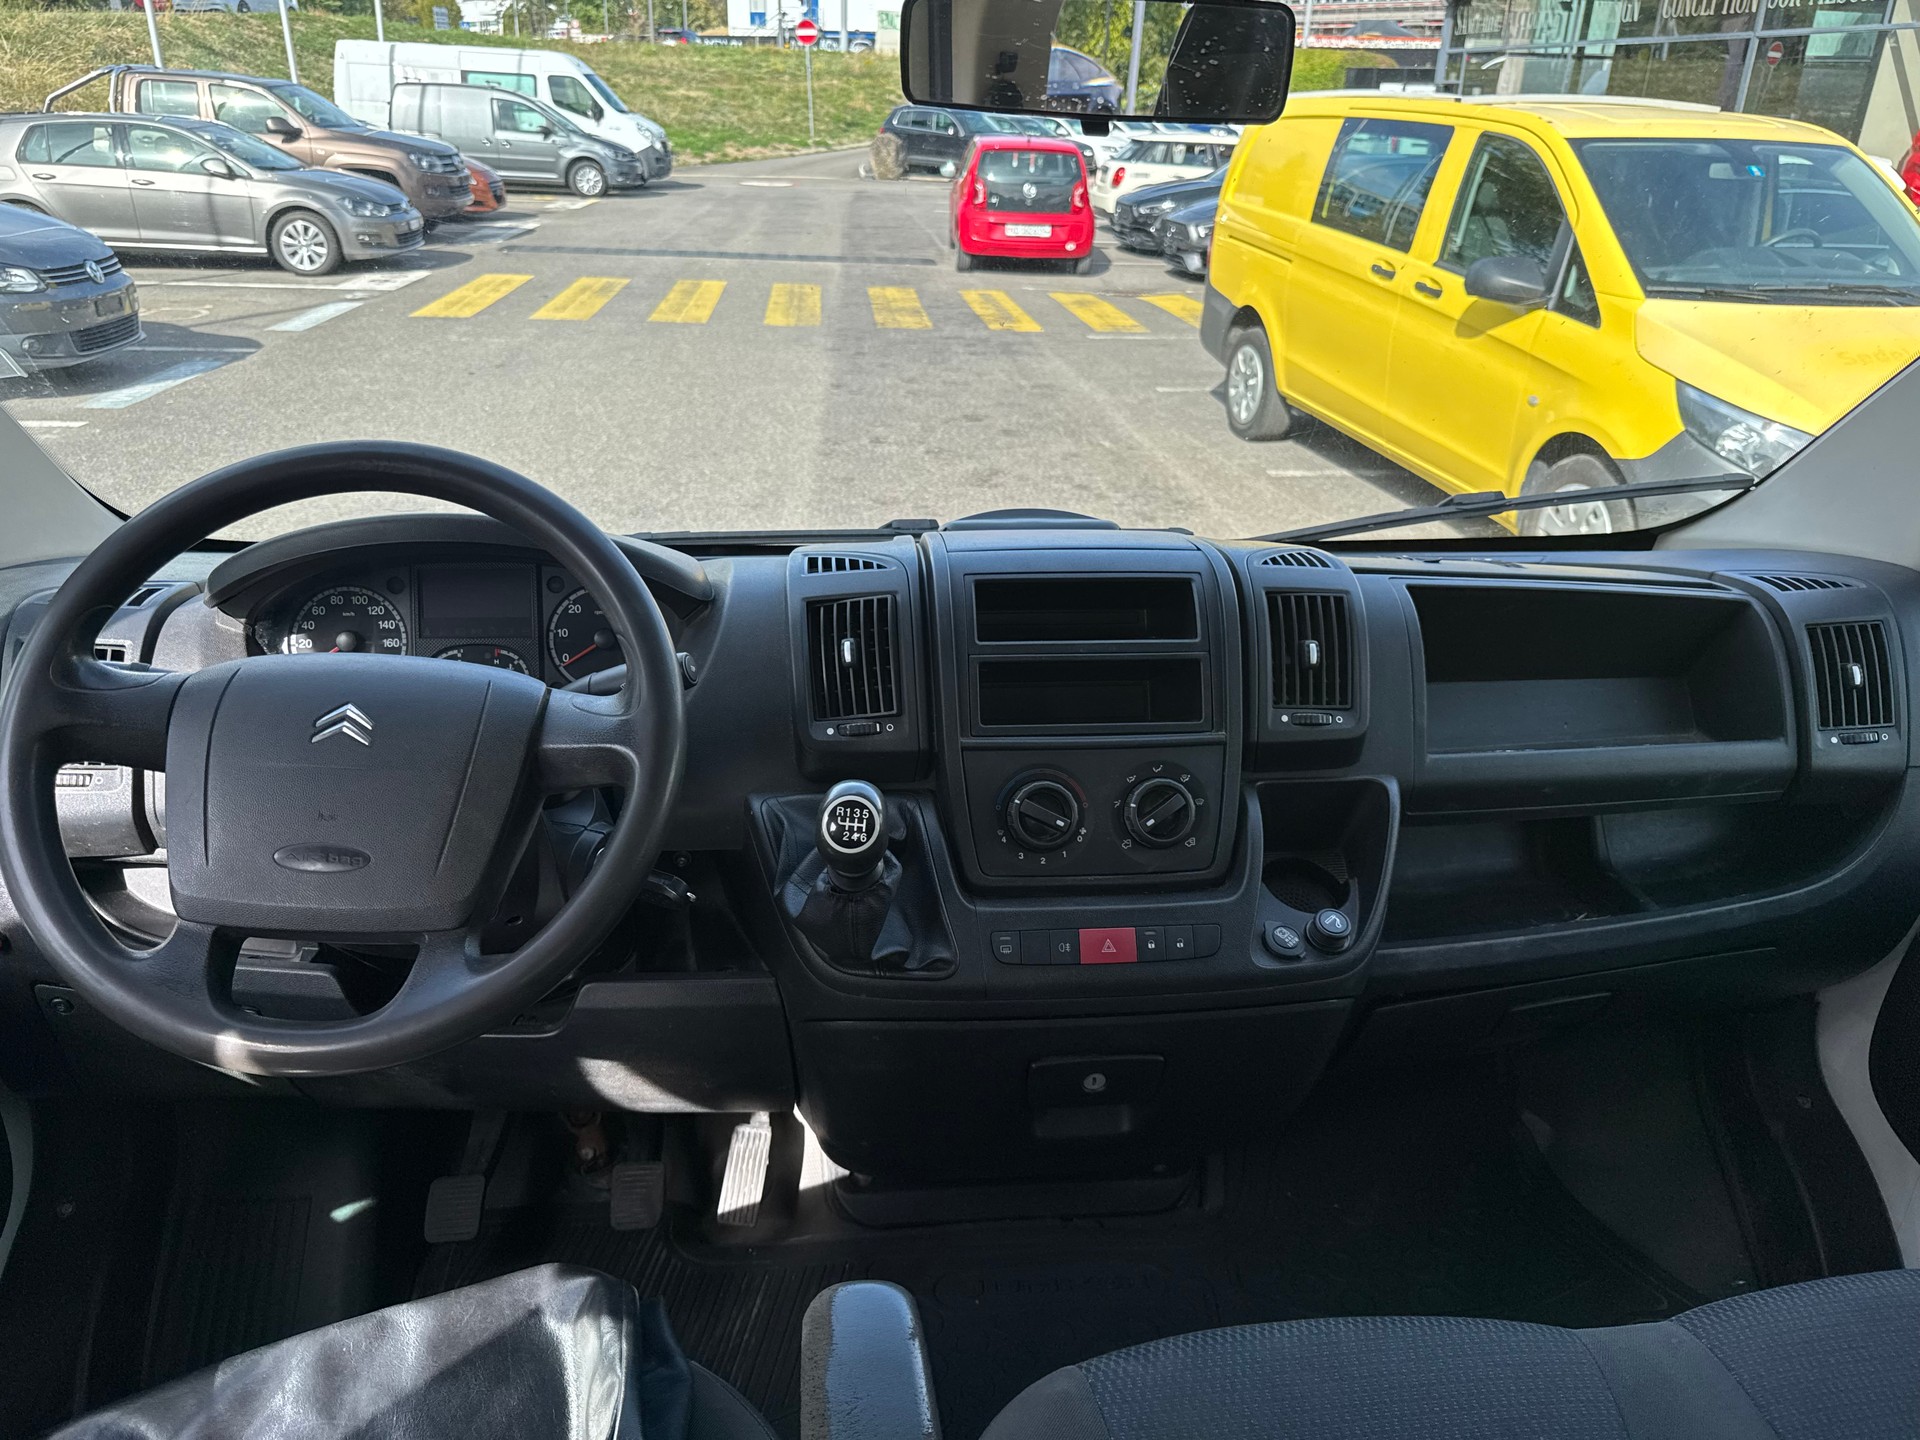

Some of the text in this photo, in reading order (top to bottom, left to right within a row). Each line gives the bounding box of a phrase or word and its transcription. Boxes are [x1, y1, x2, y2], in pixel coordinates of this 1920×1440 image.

[330, 595, 344, 605] 80
[350, 595, 369, 605] 100
[311, 606, 326, 616] 60
[367, 606, 385, 615] 120
[568, 604, 582, 614] 20
[301, 620, 315, 630] 40
[378, 620, 396, 630] 140
[557, 628, 569, 638] 10
[298, 639, 313, 649] 20
[382, 638, 400, 648] 160
[562, 653, 570, 663] 0
[836, 806, 844, 816] R
[853, 808, 861, 818] 3
[862, 809, 869, 819] 5
[842, 832, 850, 841] 2
[860, 833, 867, 842] 6
[1018, 852, 1024, 860] 3
[1040, 857, 1046, 865] 2
